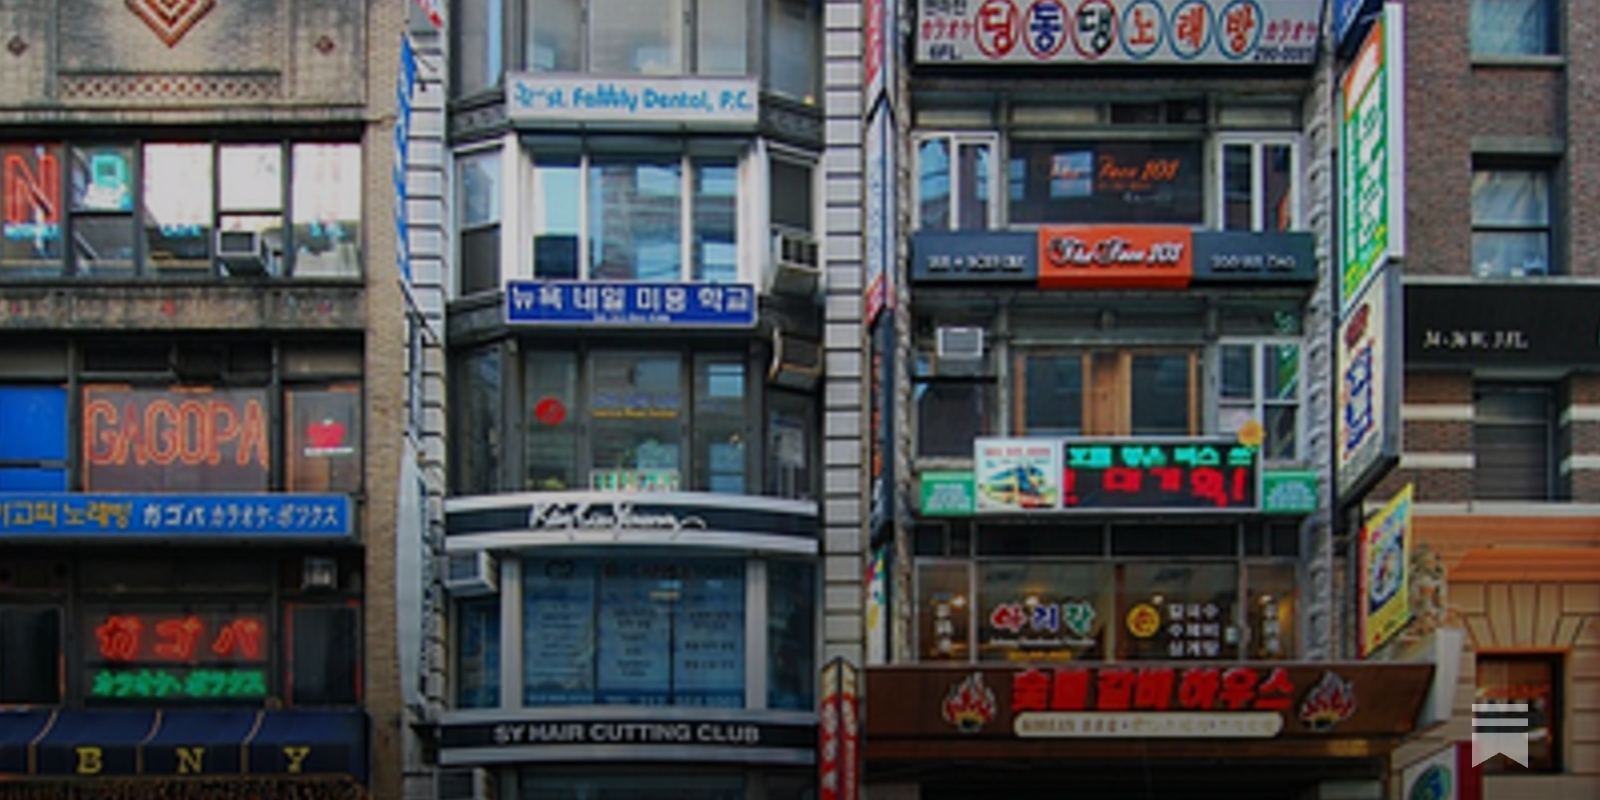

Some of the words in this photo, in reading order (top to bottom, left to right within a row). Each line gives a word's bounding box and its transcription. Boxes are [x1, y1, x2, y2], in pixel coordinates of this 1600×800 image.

[1127, 4, 1256, 54] 노래방
[643, 87, 714, 111] Dental,
[512, 285, 563, 311] 뉴욕
[572, 285, 626, 311] 네일
[635, 285, 688, 312] 미용
[697, 285, 749, 312] 학교
[85, 399, 270, 467] GAGOPA
[494, 724, 529, 745] SY
[529, 724, 586, 743] HAIR
[589, 724, 691, 743] CUTTING
[696, 723, 761, 744] CLUB
